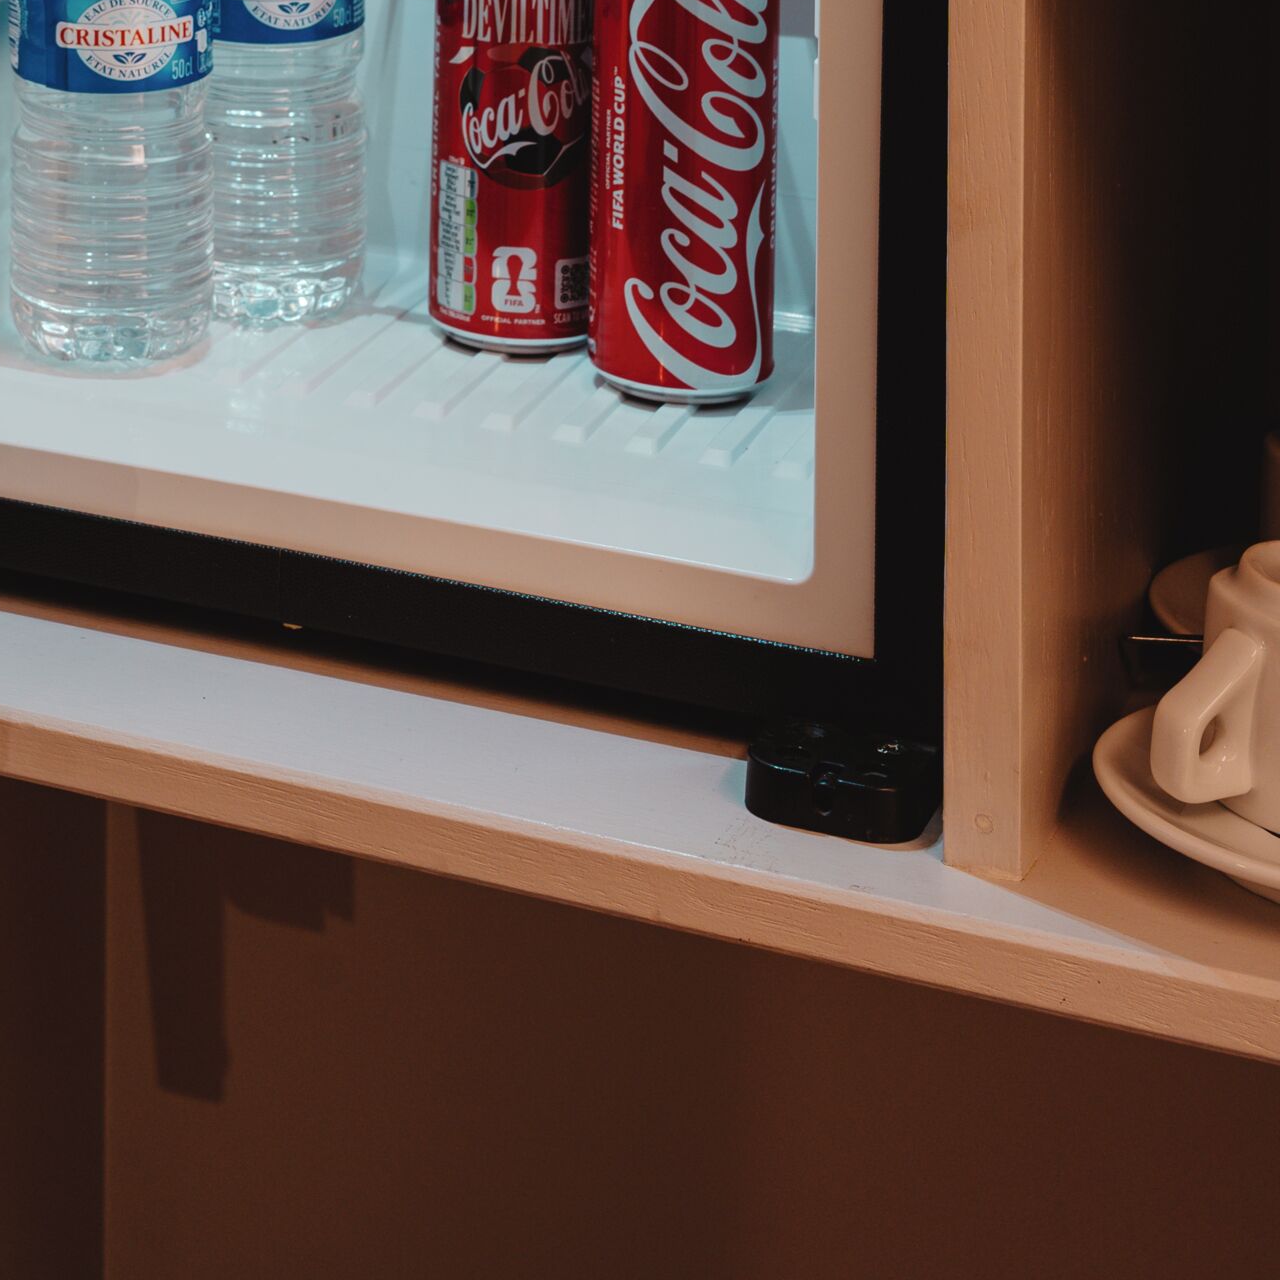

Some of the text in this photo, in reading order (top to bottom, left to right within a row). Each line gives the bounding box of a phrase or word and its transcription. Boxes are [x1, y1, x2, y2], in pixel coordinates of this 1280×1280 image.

[84, 1, 108, 22] EAU
[251, 1, 334, 28] ETAT NATUREL
[59, 20, 192, 47] CRISTALINE
[85, 52, 172, 79] ETAT NATUREL
[172, 57, 193, 80] 50cl
[613, 115, 626, 186] WORLD
[611, 190, 624, 231] FIFA
[504, 299, 524, 307] FIFA
[481, 314, 513, 325] OFFICIAL
[514, 318, 546, 326] PARTNER
